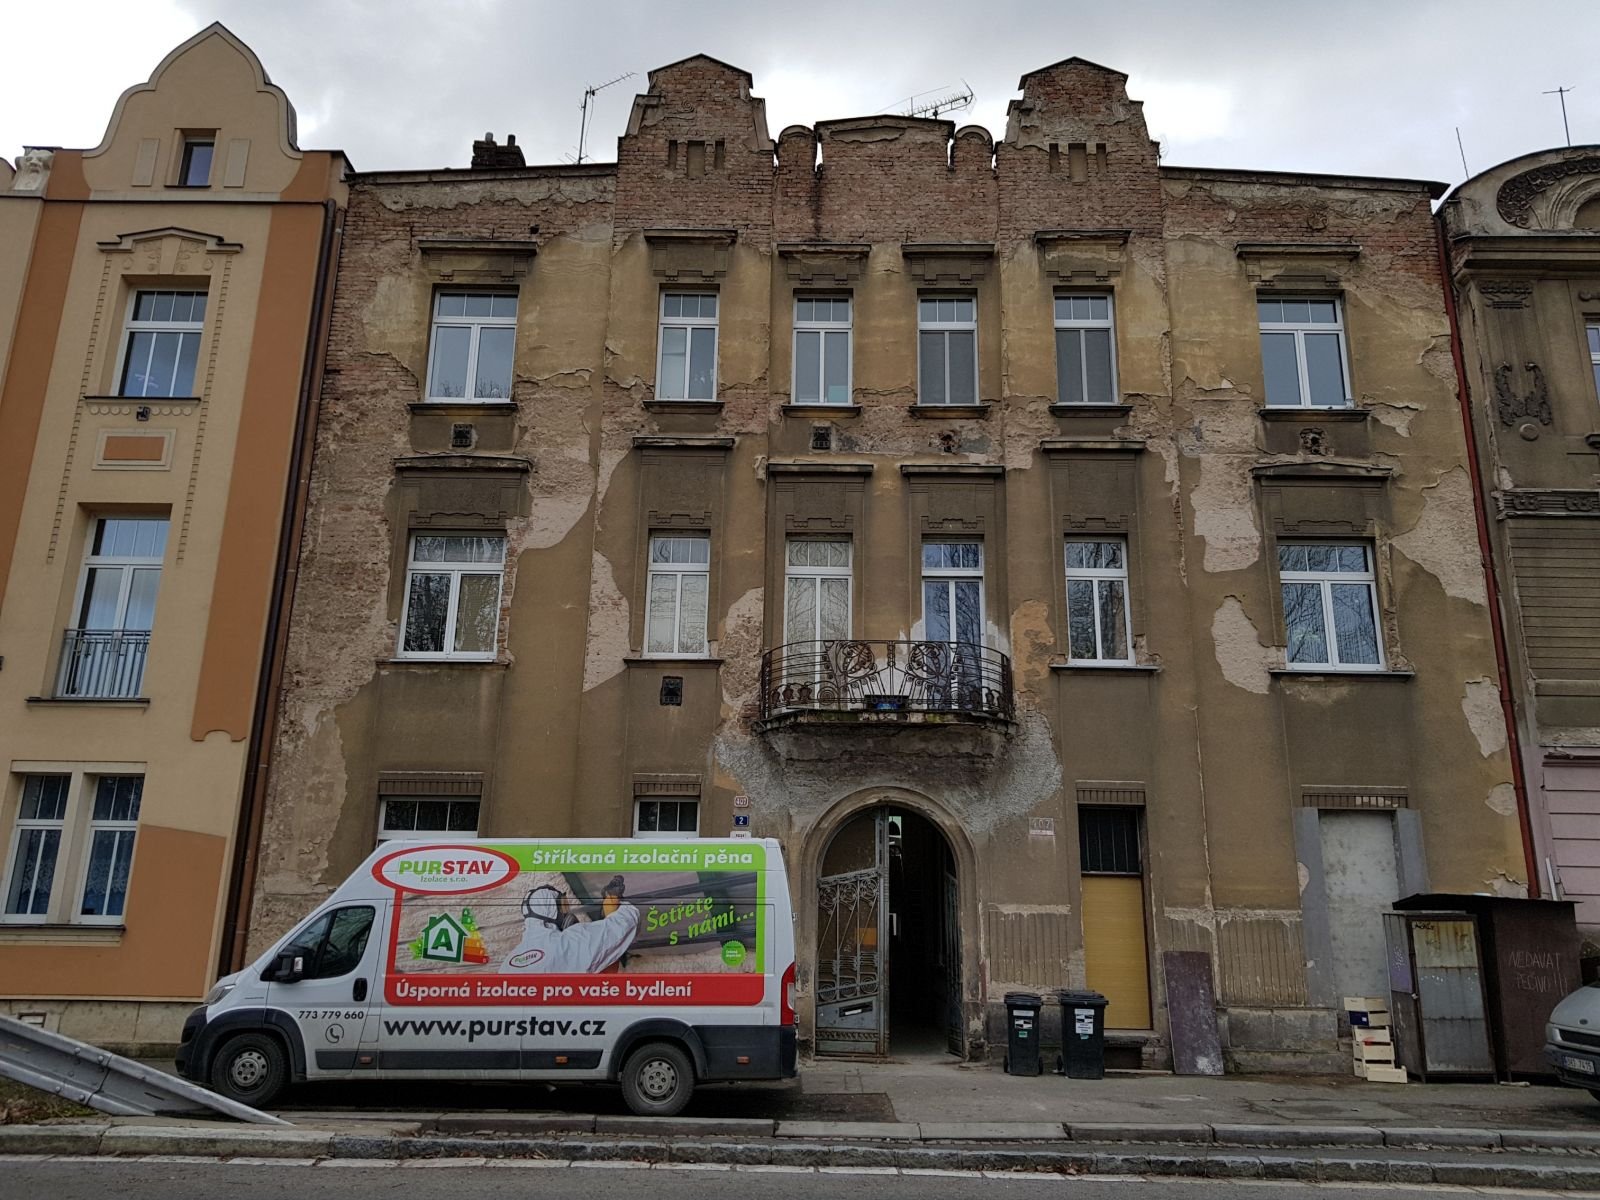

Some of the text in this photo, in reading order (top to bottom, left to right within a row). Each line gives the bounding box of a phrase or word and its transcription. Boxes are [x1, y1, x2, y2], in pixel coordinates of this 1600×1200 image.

[735, 798, 747, 806] 407
[738, 816, 744, 825] 2
[398, 860, 495, 875] PURSTAV
[532, 849, 753, 868] Stříkaná izolační pěna
[420, 875, 448, 883] Izolace
[646, 895, 714, 932] Šetřete
[669, 905, 755, 945] s námi...
[431, 928, 454, 952] A
[395, 979, 692, 1001] Úsporná izolace pro vaše bydlení
[298, 1010, 365, 1020] 773 779 660
[384, 1016, 607, 1043] www.purstav.cz
